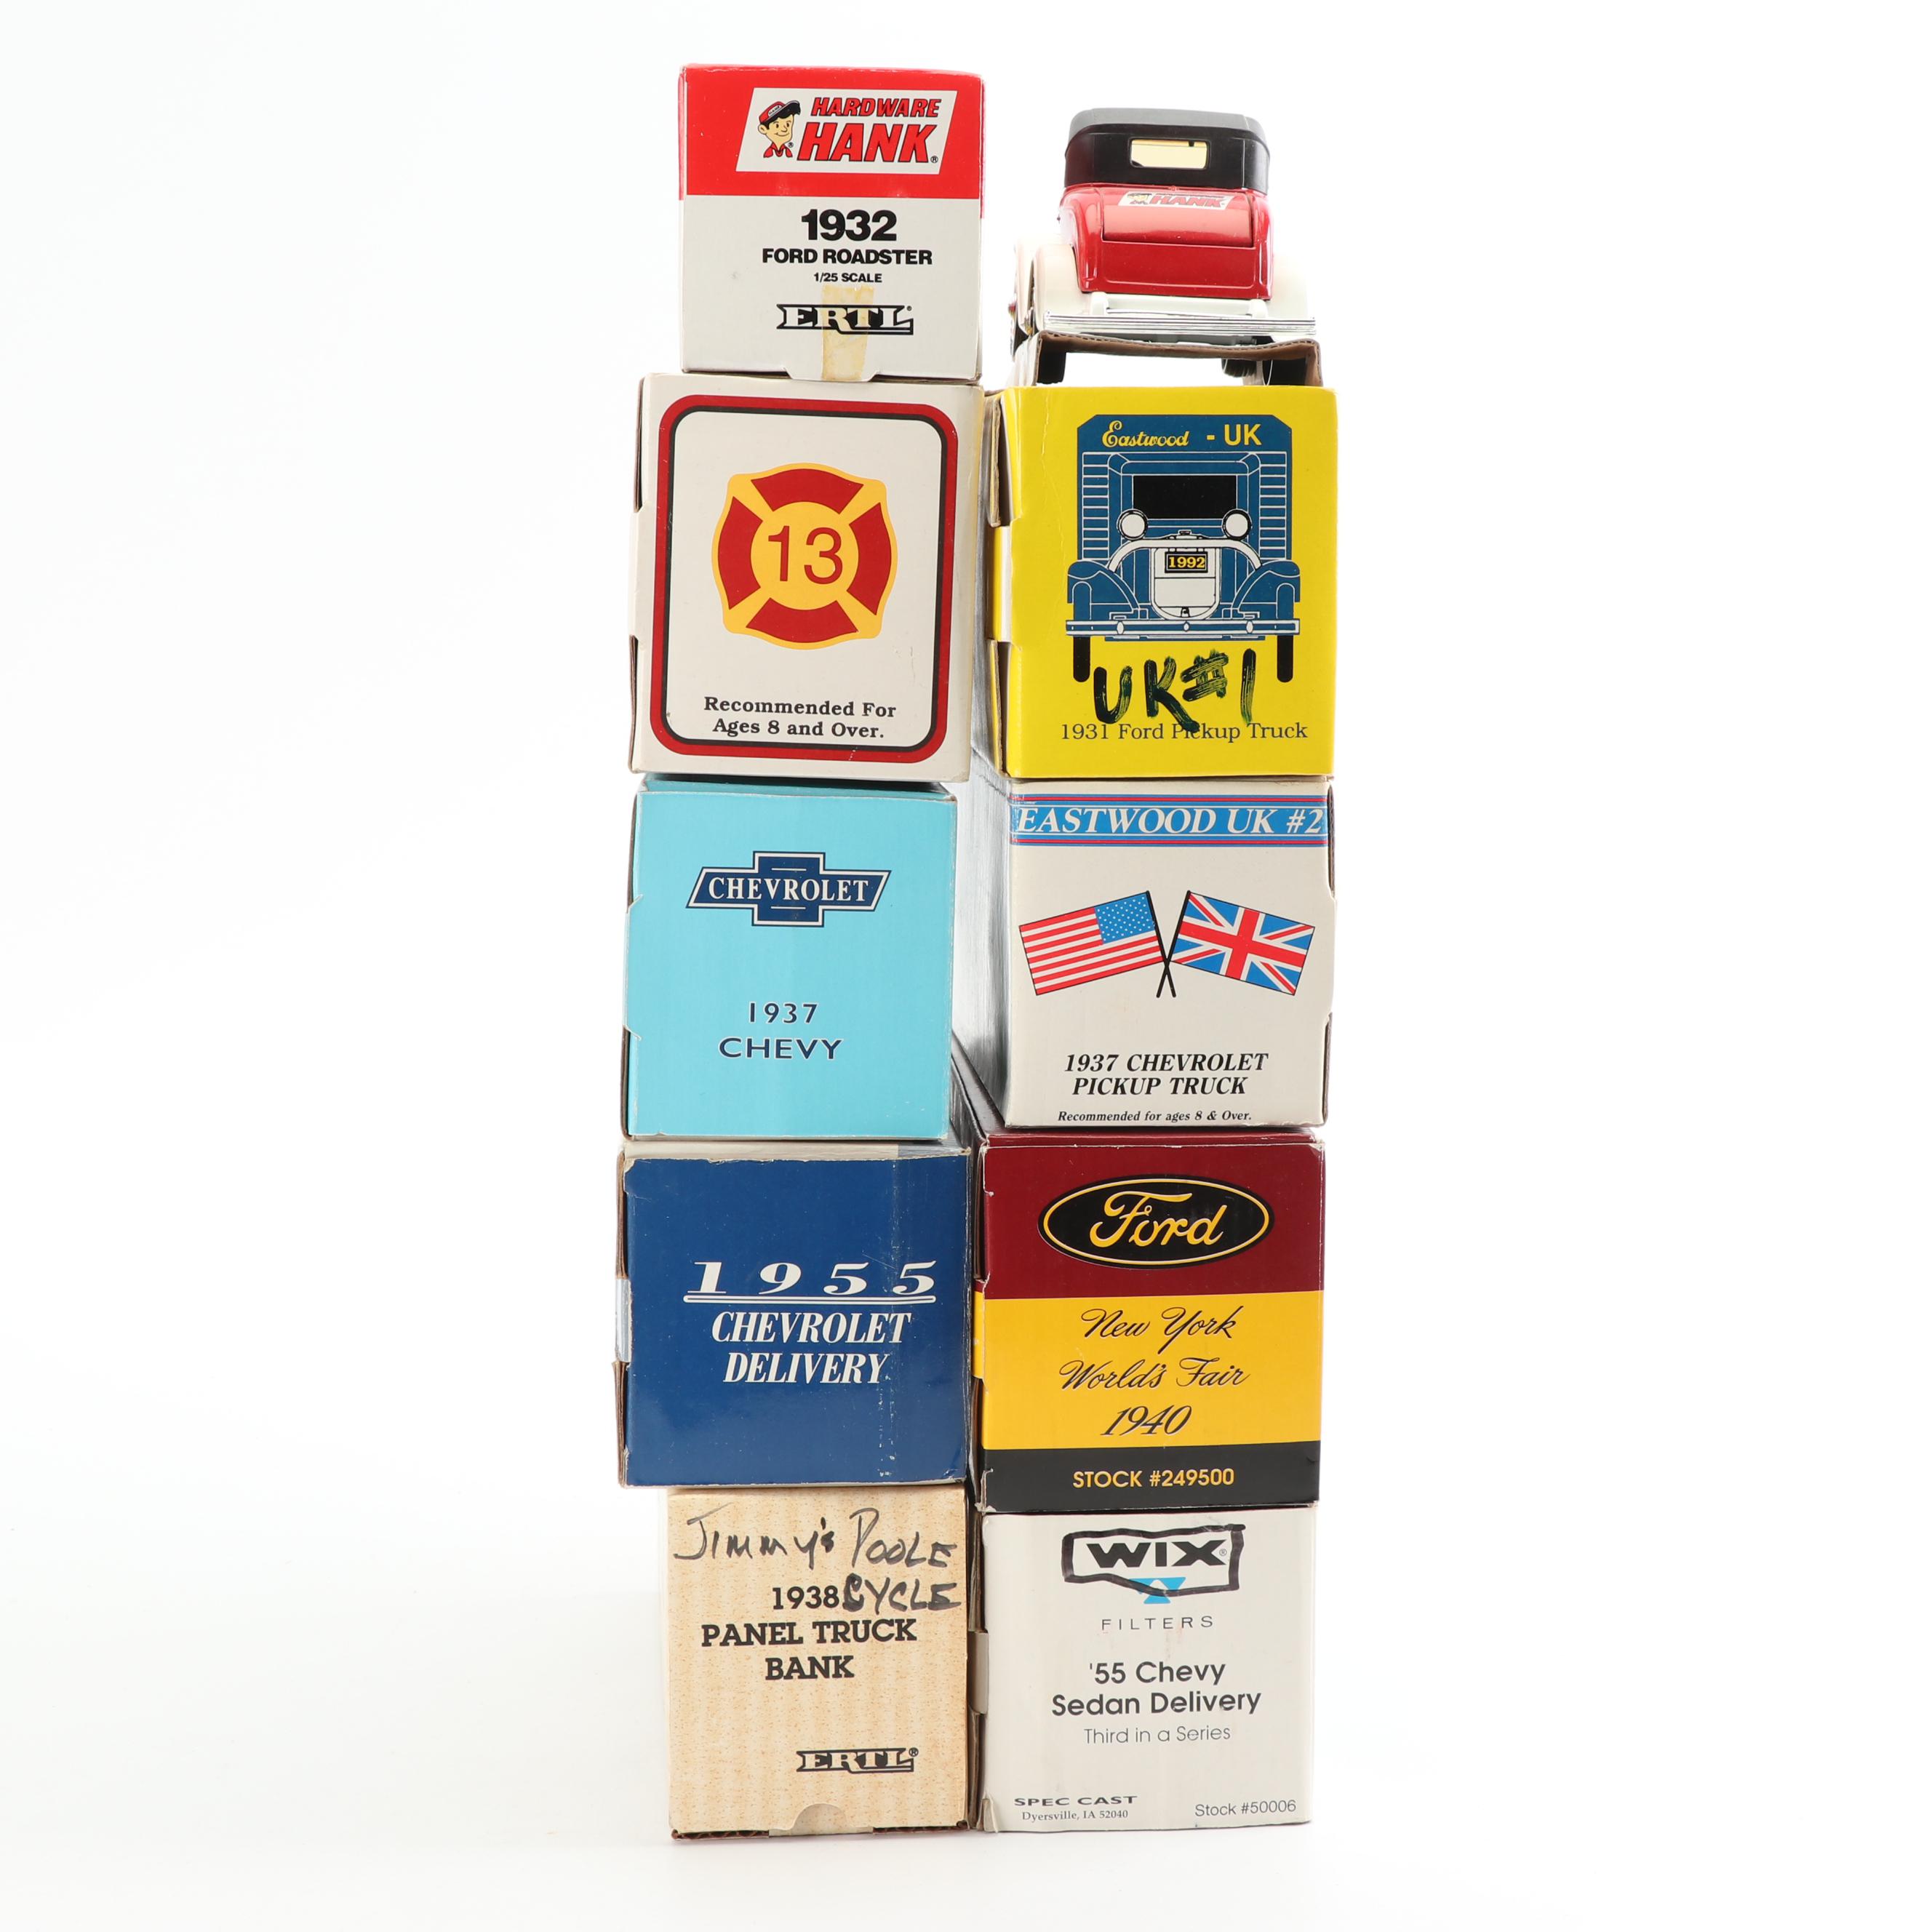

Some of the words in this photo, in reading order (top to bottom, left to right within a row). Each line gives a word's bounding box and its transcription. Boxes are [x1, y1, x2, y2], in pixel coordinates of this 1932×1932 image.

[811, 97, 941, 118] HARDWARE
[797, 122, 938, 163] HANK
[1149, 195, 1224, 207] HANK
[801, 209, 897, 242] 1932
[762, 248, 818, 264] FORD
[823, 250, 933, 265] ROADSTER
[813, 273, 838, 283] 1/25
[841, 273, 882, 283] SCALE
[777, 303, 914, 335] ERTL
[1102, 420, 1189, 448] Eastwood
[1224, 424, 1261, 446] UK
[768, 525, 843, 585] 13
[1168, 556, 1205, 569] 1992
[704, 696, 855, 716] Recommended
[863, 703, 896, 718] For
[713, 719, 760, 738] Ages
[768, 721, 780, 735] 8
[787, 722, 823, 736] and
[832, 723, 884, 738] Over.
[1061, 723, 1108, 740] 1931
[1119, 723, 1164, 740] Ford
[1247, 722, 1308, 739] Truck
[1017, 807, 1216, 834] EASTWOOD
[1227, 808, 1280, 834] UK
[1286, 810, 1323, 834] #2
[708, 877, 869, 901] CHEVROLET
[749, 1002, 818, 1023] 1937
[718, 1037, 843, 1060] CHEVY
[1064, 1054, 1119, 1071] 1937
[1127, 1053, 1269, 1071] CHEVROLET
[1072, 1077, 1161, 1095] PICKUP
[1169, 1077, 1248, 1095] TRUCK
[1058, 1110, 1141, 1122] Recommended
[1144, 1110, 1162, 1122] for
[1165, 1113, 1191, 1123] ages
[1195, 1111, 1202, 1121] 8
[1207, 1111, 1217, 1121] &
[1221, 1110, 1252, 1121] Over.
[1090, 1191, 1228, 1248] Ford
[687, 1261, 936, 1295] 1955
[711, 1312, 911, 1344] CHEVROLET
[1081, 1309, 1150, 1338] New
[1158, 1306, 1244, 1354] York
[723, 1352, 890, 1384] DELIVERY
[1058, 1359, 1167, 1391] World's
[1175, 1357, 1251, 1386] Fair
[1100, 1405, 1192, 1437] 1940
[1073, 1471, 1142, 1488] STOCK
[1149, 1468, 1234, 1487] #249500
[1086, 1539, 1226, 1568] WIX
[772, 1586, 839, 1610] 1938
[842, 1573, 962, 1615] CYCLE
[701, 1622, 805, 1648] PANEL
[813, 1618, 917, 1644] TRUCK
[1101, 1616, 1213, 1630] FILTERS
[765, 1655, 854, 1680] BANK
[1089, 1661, 1125, 1684] '55
[1135, 1661, 1226, 1686] Chevy
[1052, 1694, 1140, 1717] Sedan
[1151, 1691, 1261, 1715] Delivery
[1084, 1728, 1129, 1744] Third
[1135, 1727, 1151, 1743] in
[1157, 1731, 1170, 1742] a
[1176, 1725, 1231, 1741] Series
[797, 1747, 914, 1773] ERTL
[1014, 1797, 1070, 1807] SPEC
[1077, 1795, 1138, 1806] CAST
[1194, 1803, 1237, 1817] Stock
[1240, 1800, 1296, 1815] #50006
[1021, 1811, 1080, 1822] Dyersville,
[1082, 1810, 1096, 1820] IA
[1099, 1809, 1129, 1819] 52040
